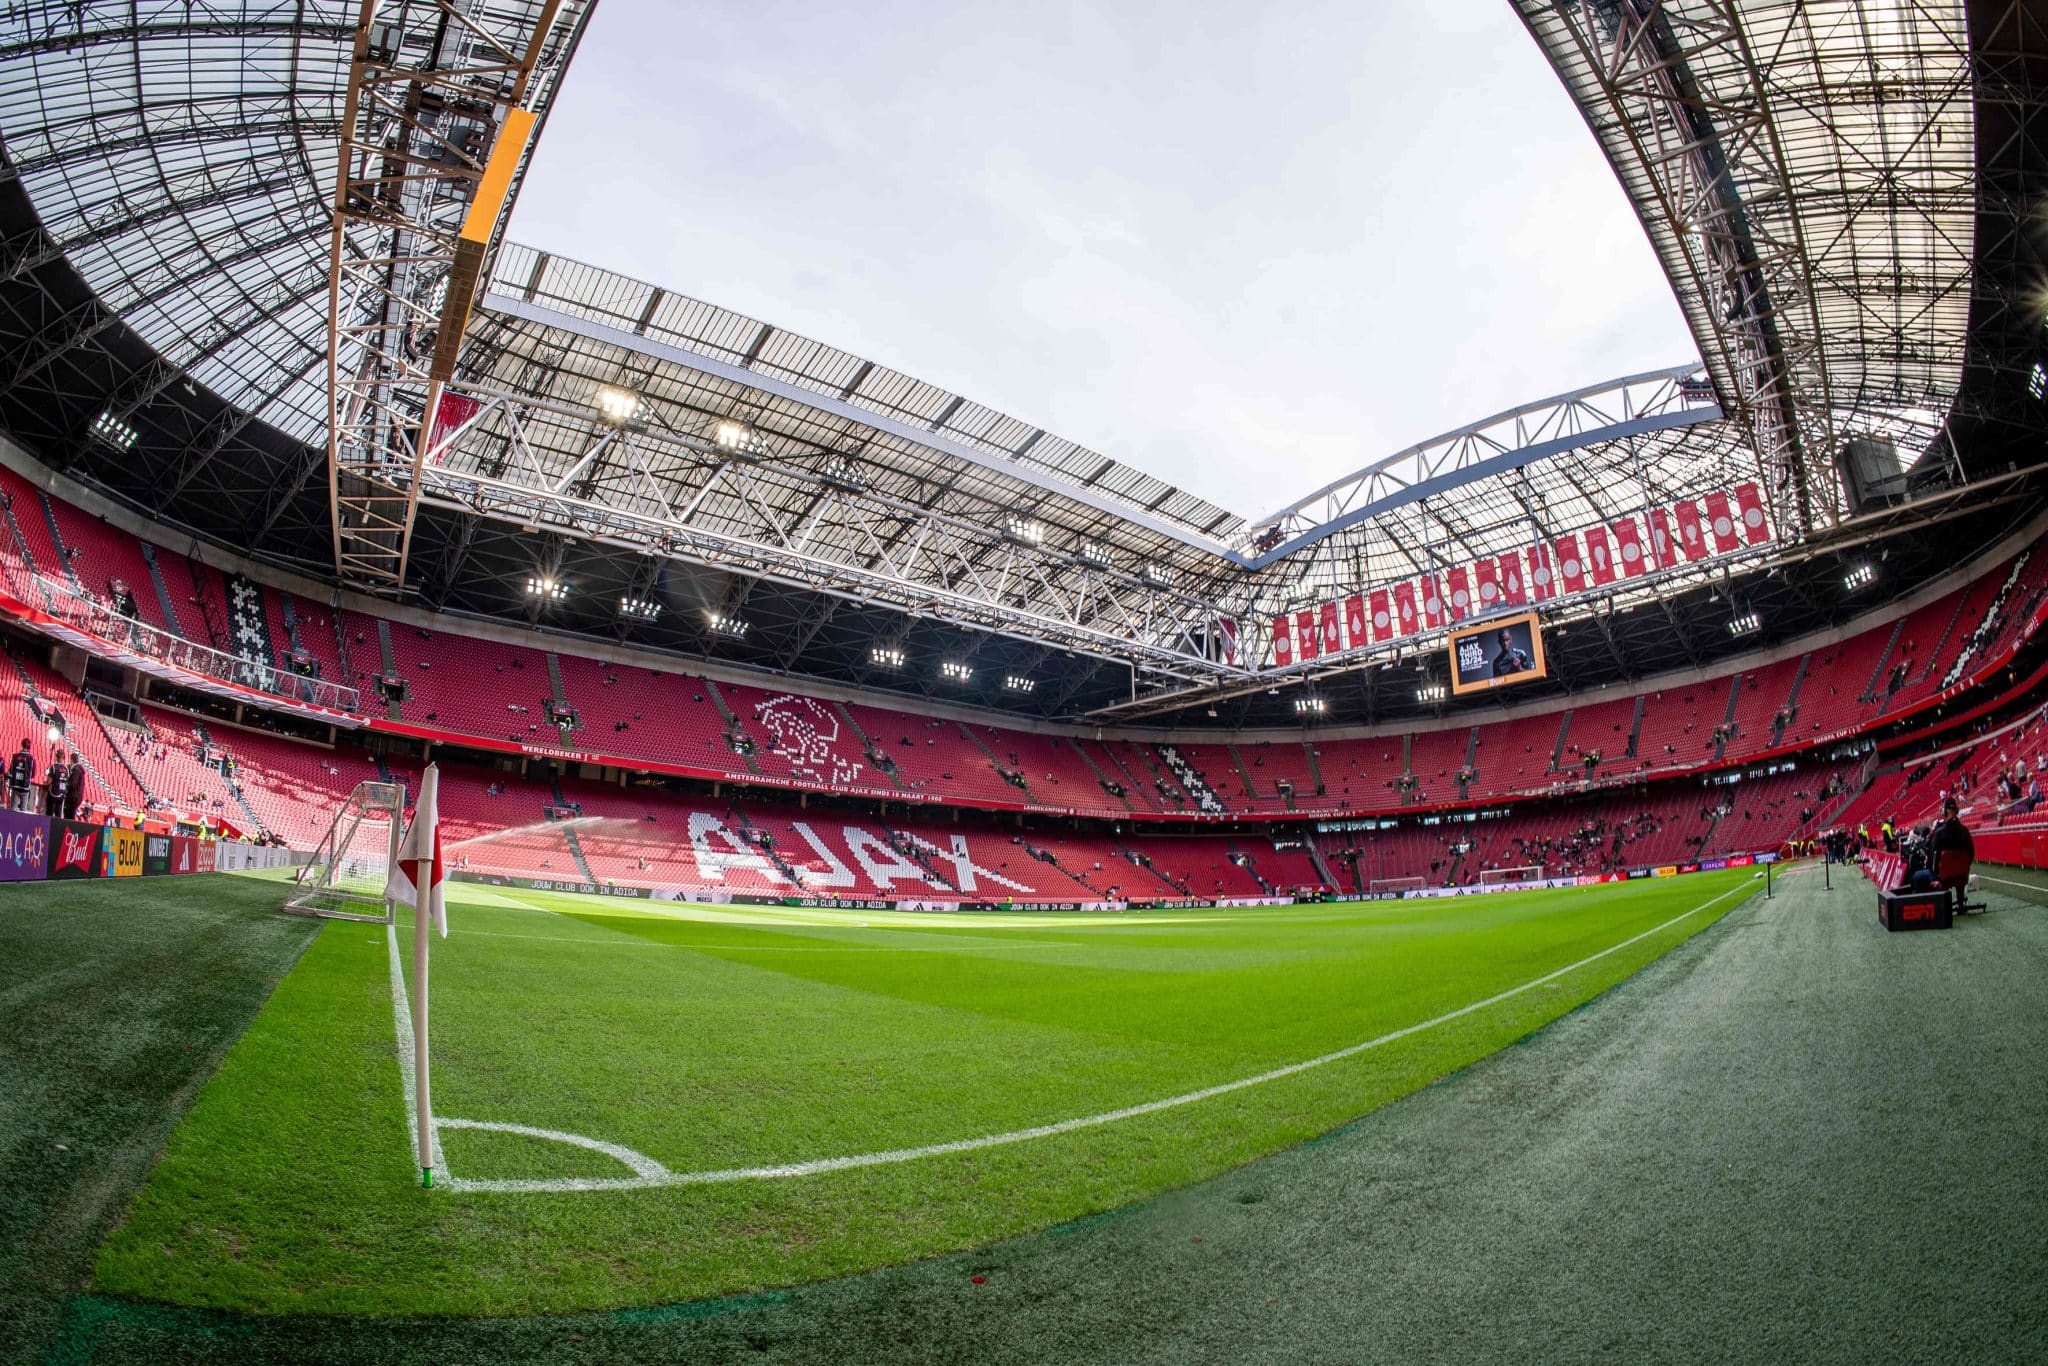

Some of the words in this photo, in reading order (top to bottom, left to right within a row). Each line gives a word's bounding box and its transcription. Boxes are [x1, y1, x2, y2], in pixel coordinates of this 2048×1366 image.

[1459, 642, 1479, 653] AJAX
[521, 744, 582, 760] WERELDBEKER
[724, 772, 790, 786] AMSTERDAMSCHE
[793, 780, 829, 790] FOOTBALL
[831, 784, 849, 793] CLUB
[850, 786, 869, 795] AJAX
[65, 832, 90, 864] Bud
[118, 839, 142, 867] BLOX
[148, 835, 170, 858] UNIBET
[687, 811, 1037, 893] AJAX
[531, 879, 552, 890] JOUW
[555, 882, 576, 892] CLUB
[580, 883, 595, 893] OOK
[600, 885, 610, 895] IN
[613, 886, 638, 897] ADIDA
[800, 899, 817, 907] JOUW
[820, 900, 837, 908] CLUB
[840, 900, 853, 908] OOK
[856, 901, 864, 909] IN
[867, 901, 887, 909] ADIDA
[1903, 903, 1936, 920] ESPN
